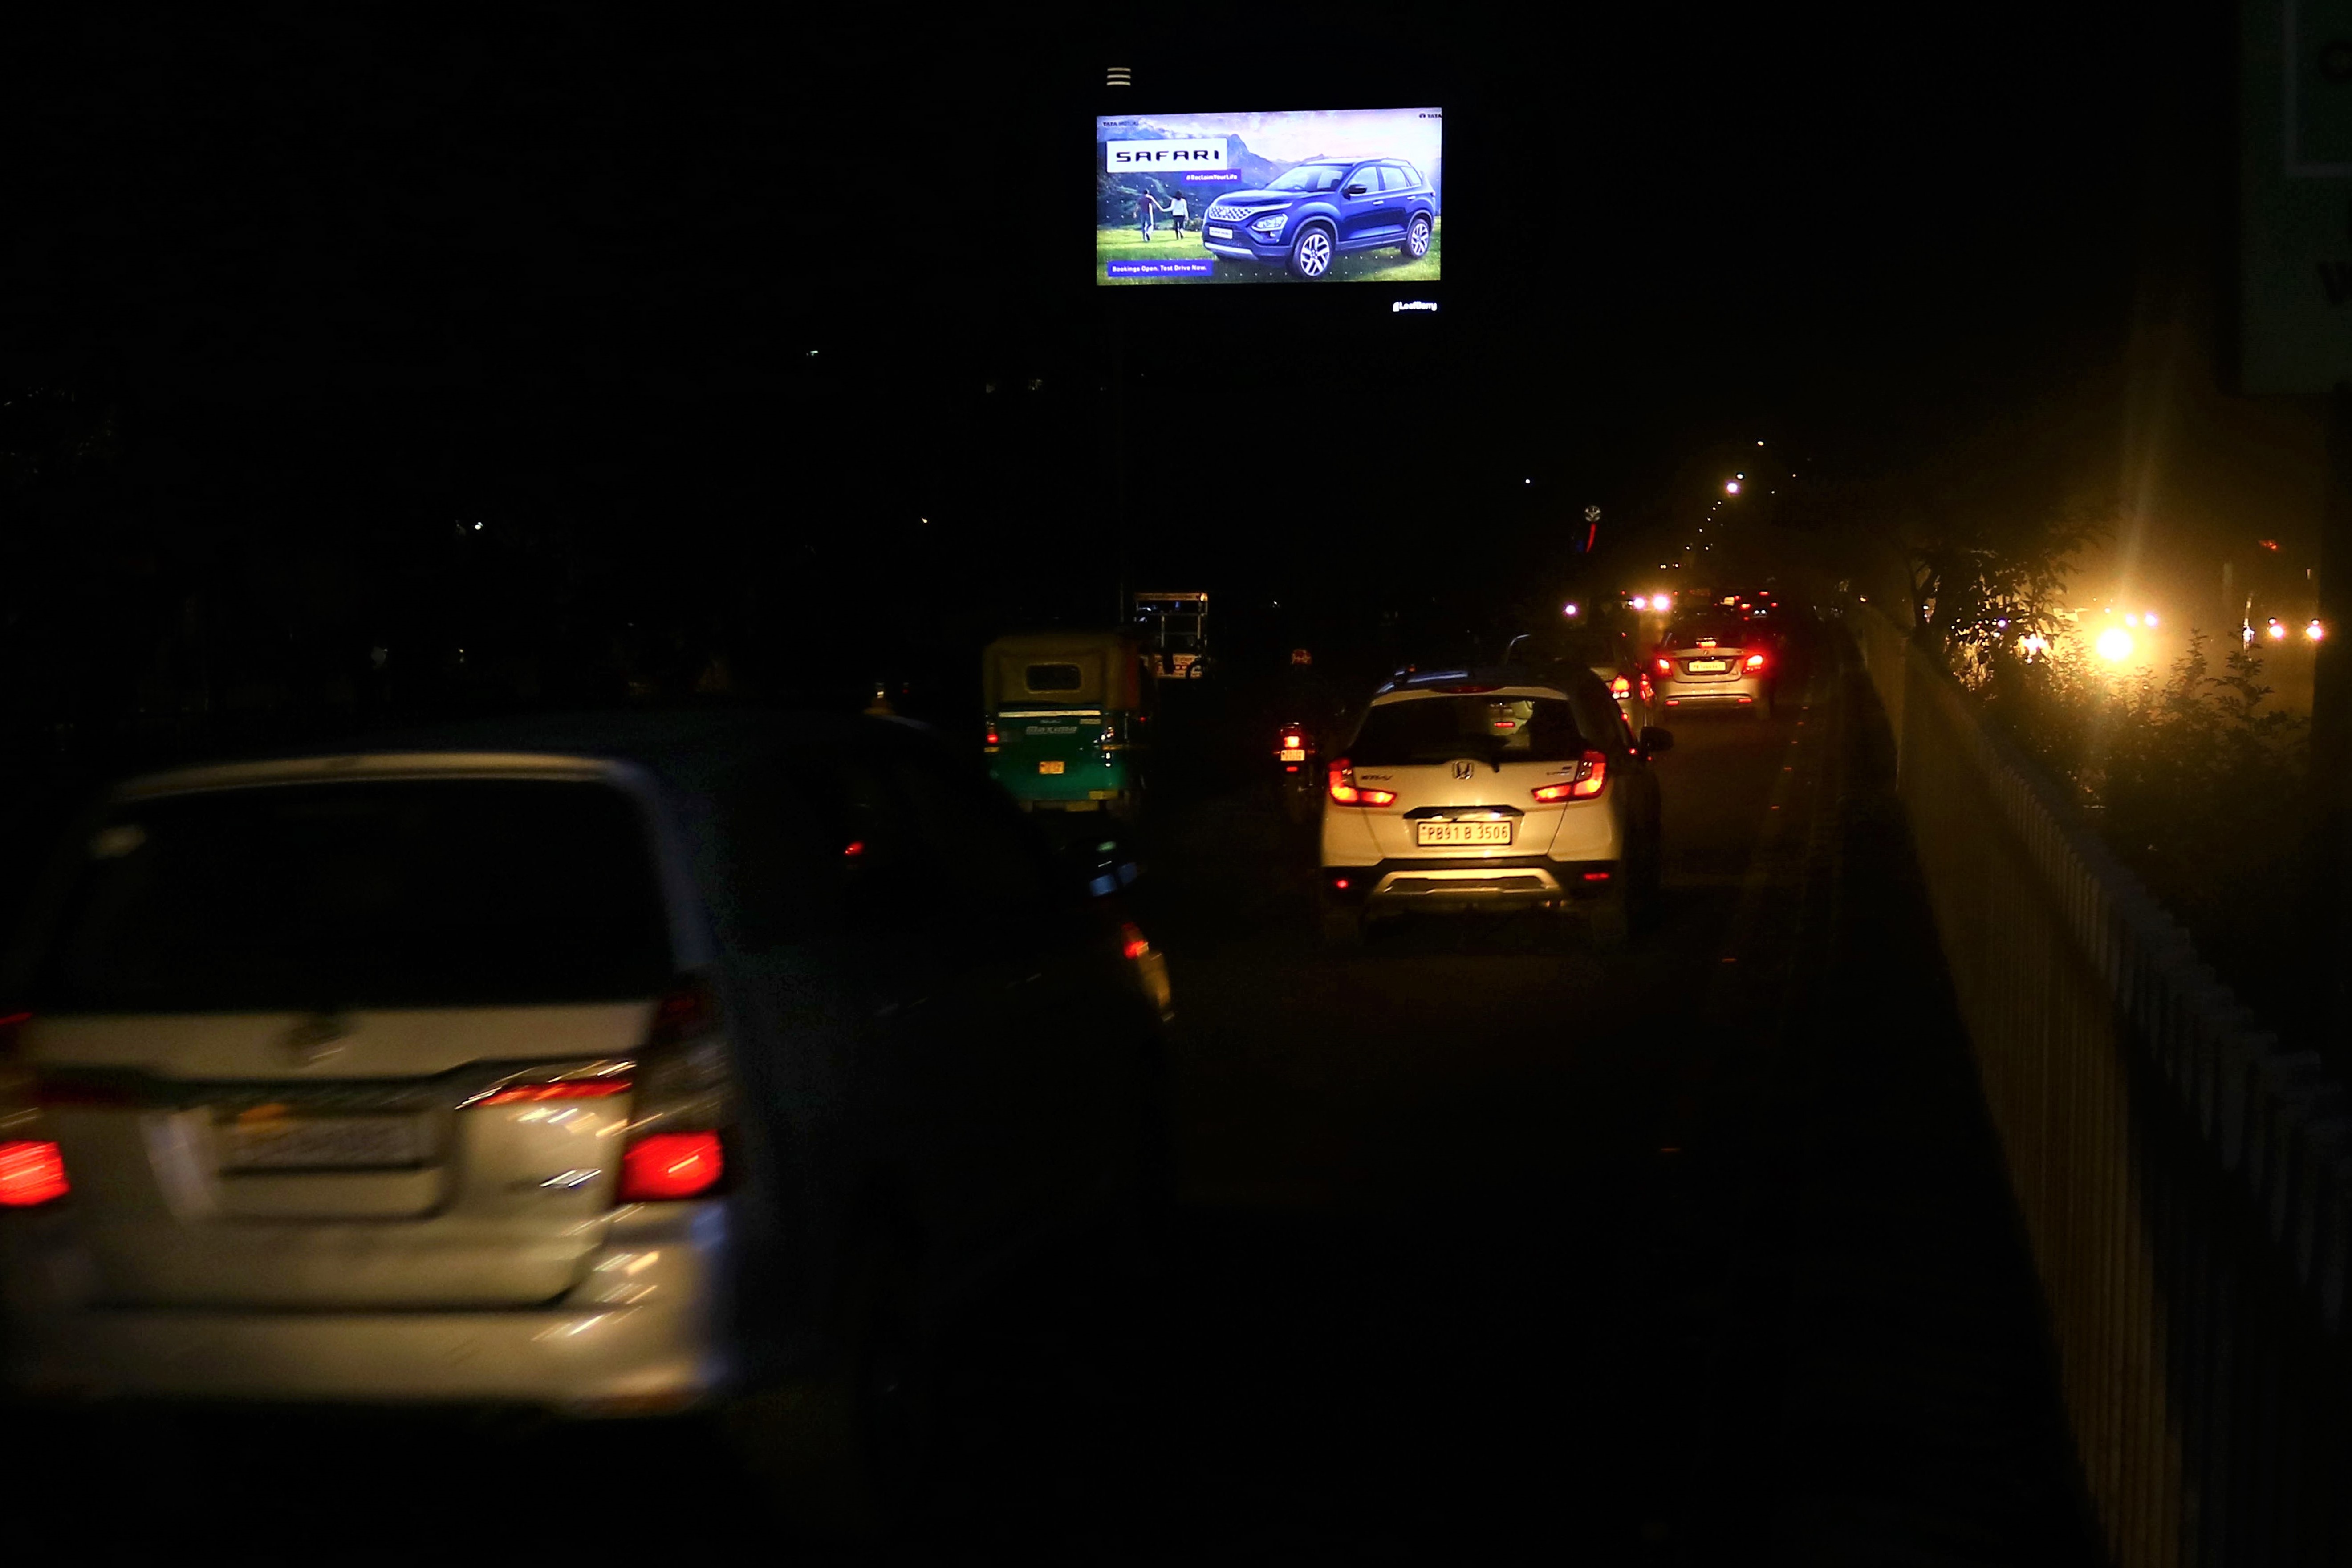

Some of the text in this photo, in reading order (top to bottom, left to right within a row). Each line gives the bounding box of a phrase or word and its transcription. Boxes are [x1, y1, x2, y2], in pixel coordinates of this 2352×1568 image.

[1116, 150, 1219, 162] SAFARI
[1428, 826, 1458, 840] PB91
[1477, 825, 1508, 840] 3506
